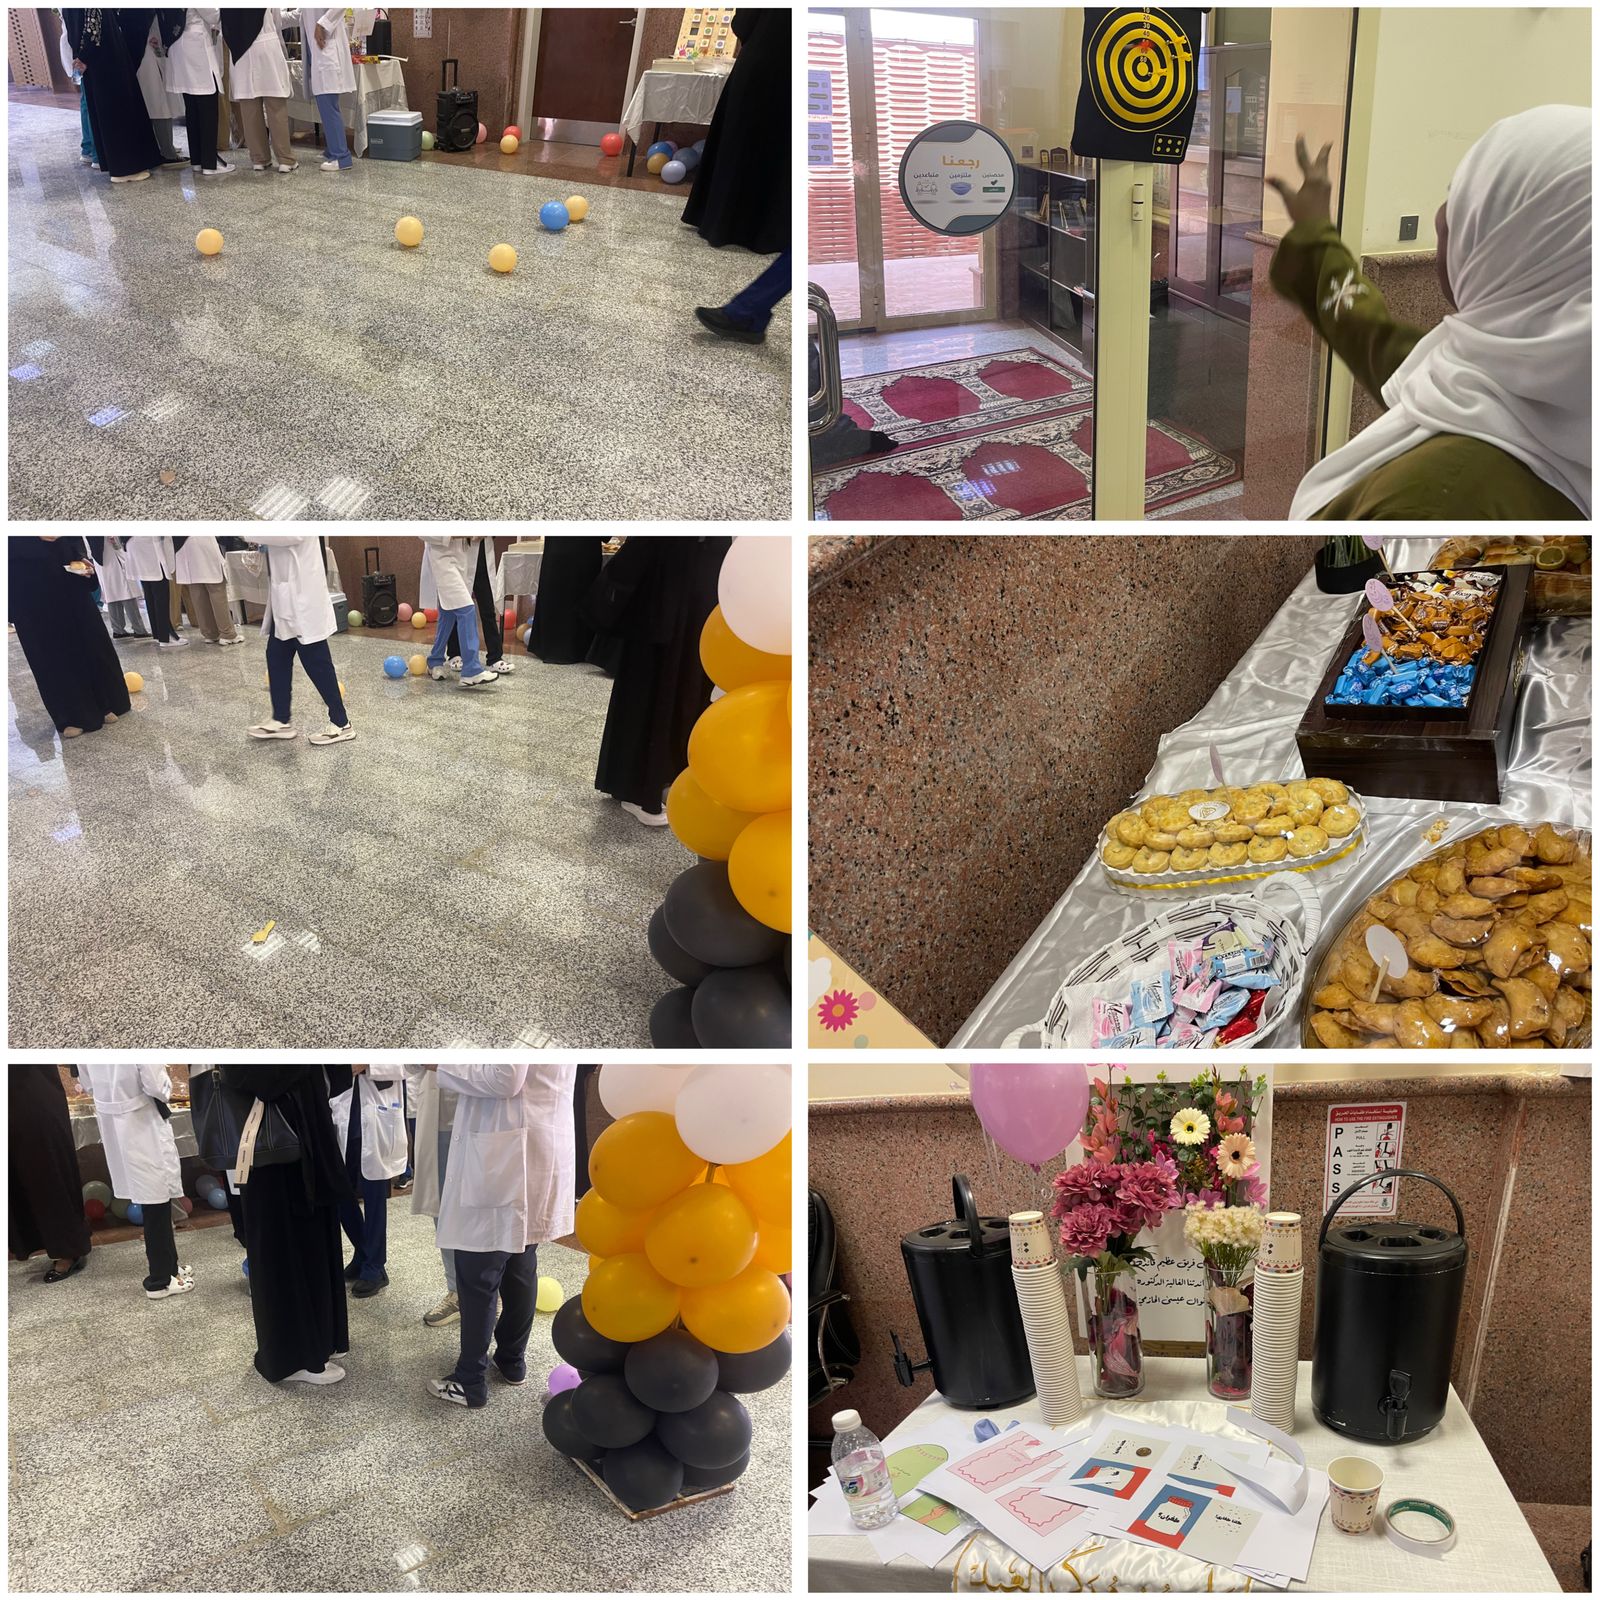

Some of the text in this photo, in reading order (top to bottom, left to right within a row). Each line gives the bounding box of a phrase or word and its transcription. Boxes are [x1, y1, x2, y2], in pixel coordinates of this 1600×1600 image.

[942, 155, 980, 169] رجعنا
[1335, 1128, 1344, 1139] P
[1333, 1146, 1343, 1157] A
[1333, 1164, 1341, 1174] S
[1332, 1182, 1340, 1193] S
[1157, 1257, 1175, 1271] عظيم
[1176, 1258, 1195, 1271] فريق
